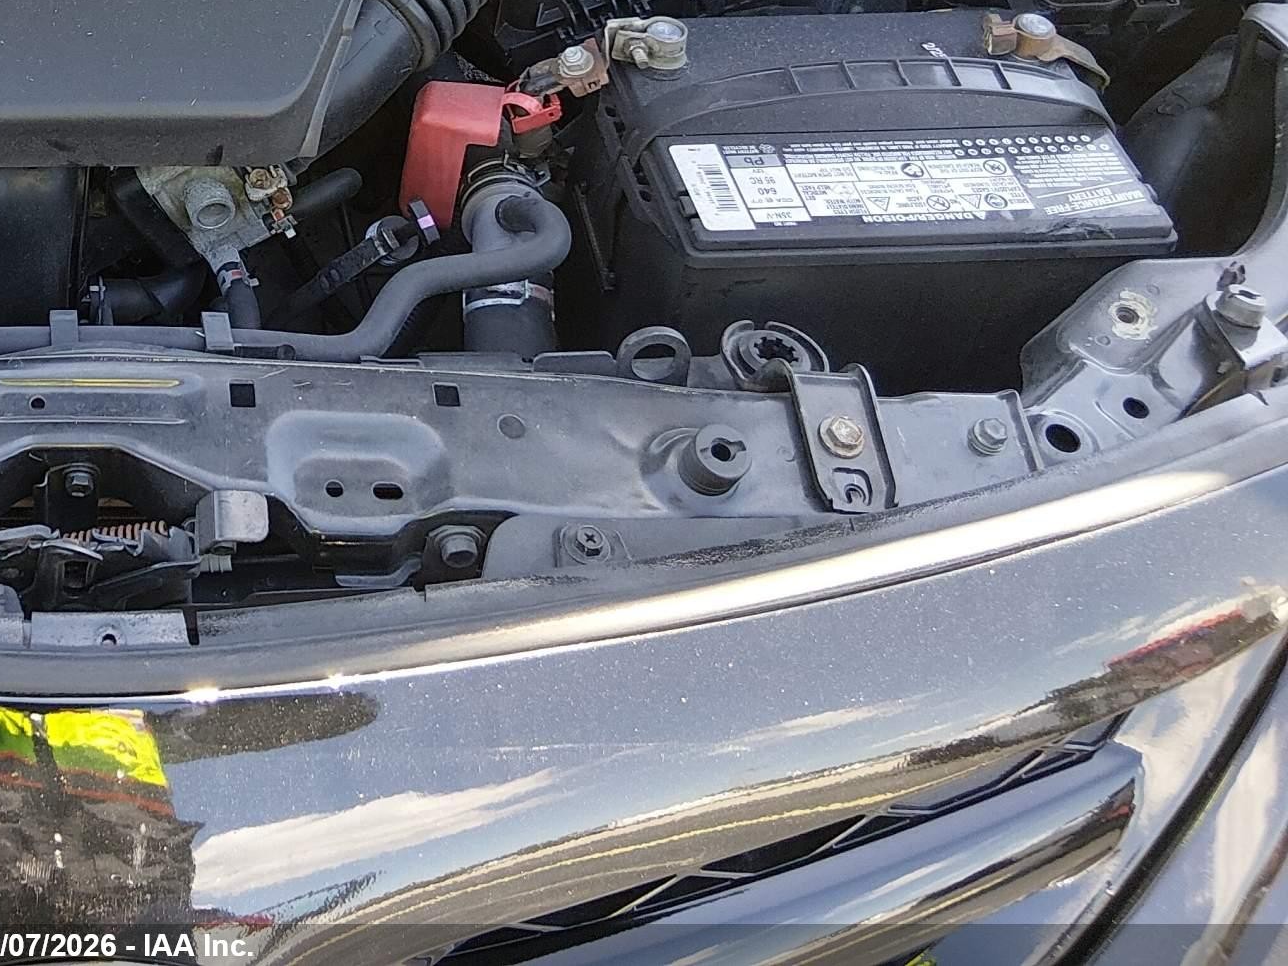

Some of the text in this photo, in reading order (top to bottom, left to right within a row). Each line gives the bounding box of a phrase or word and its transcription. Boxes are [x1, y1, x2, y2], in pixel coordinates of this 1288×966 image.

[744, 157, 765, 165] Pb
[749, 176, 763, 184] RC
[757, 187, 777, 195] 640
[1067, 187, 1113, 202] BATTERY
[1044, 190, 1144, 215] MAINTENANCE-FREE
[862, 211, 975, 222] DANGER/POISON
